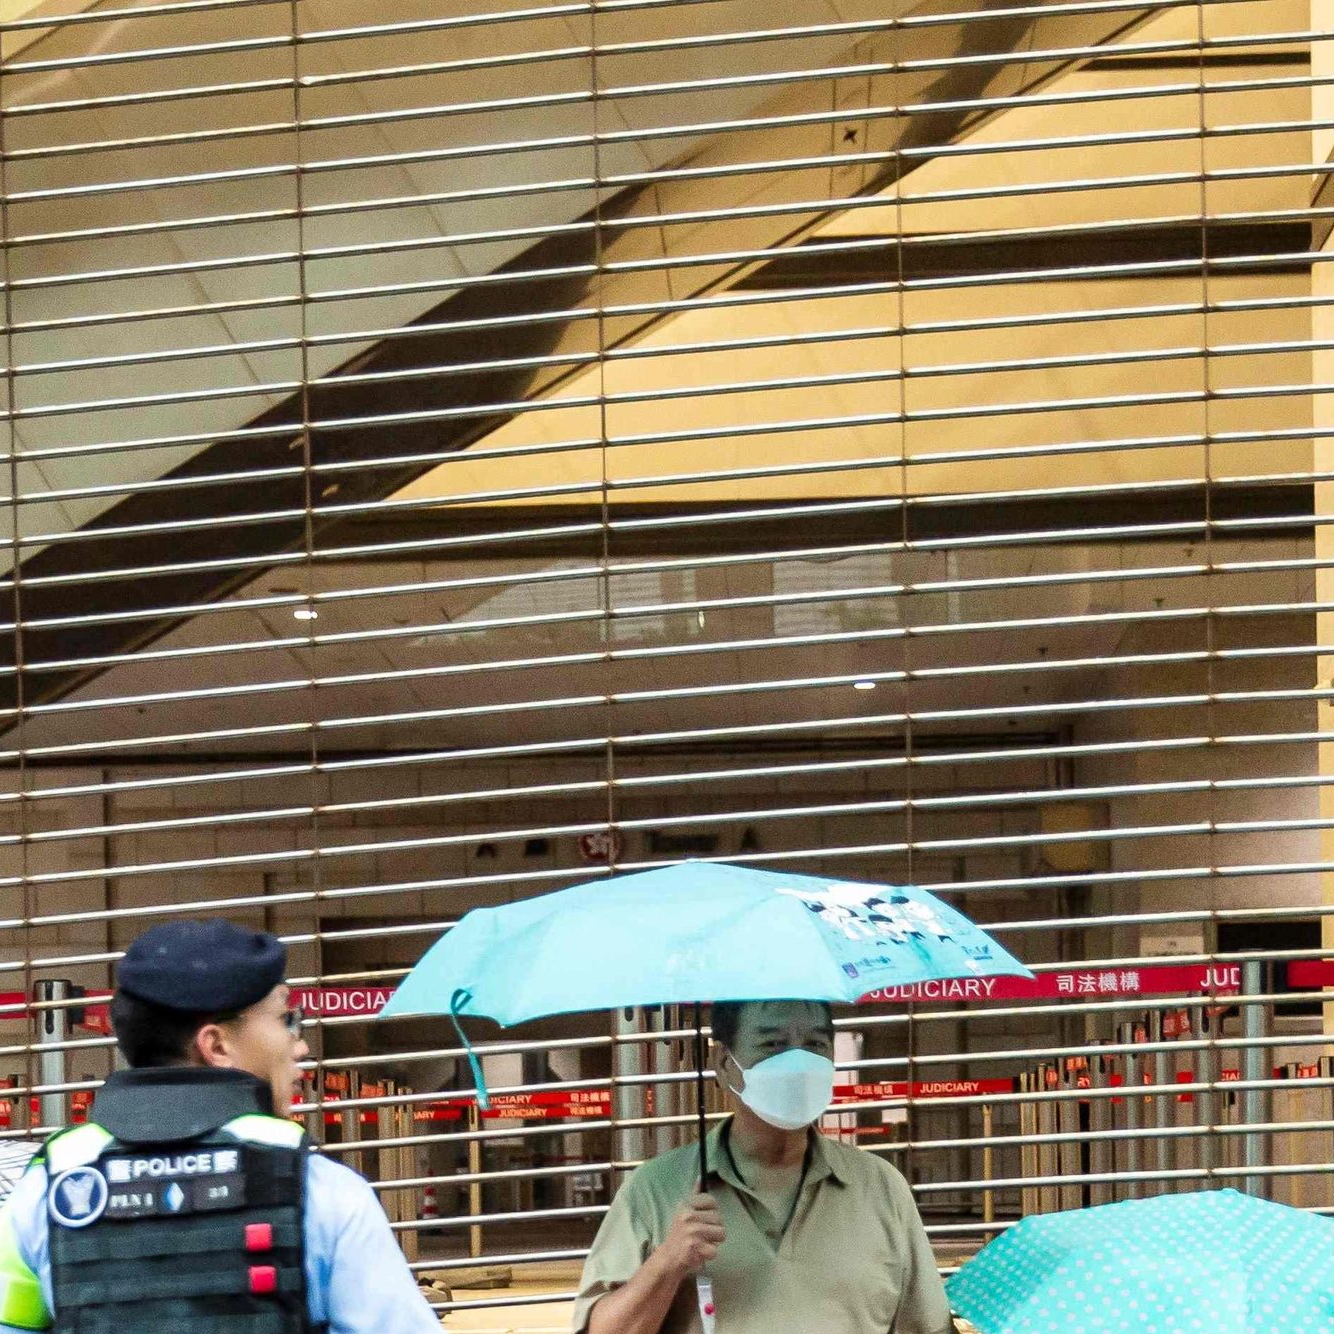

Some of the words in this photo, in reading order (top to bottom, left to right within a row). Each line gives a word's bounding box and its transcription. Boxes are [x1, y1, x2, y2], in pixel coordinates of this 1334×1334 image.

[1056, 971, 1141, 993] 司法機構
[919, 1081, 980, 1094] JUDICIARY
[498, 1108, 549, 1118] JUDICIARY
[133, 1153, 213, 1178] POLICE
